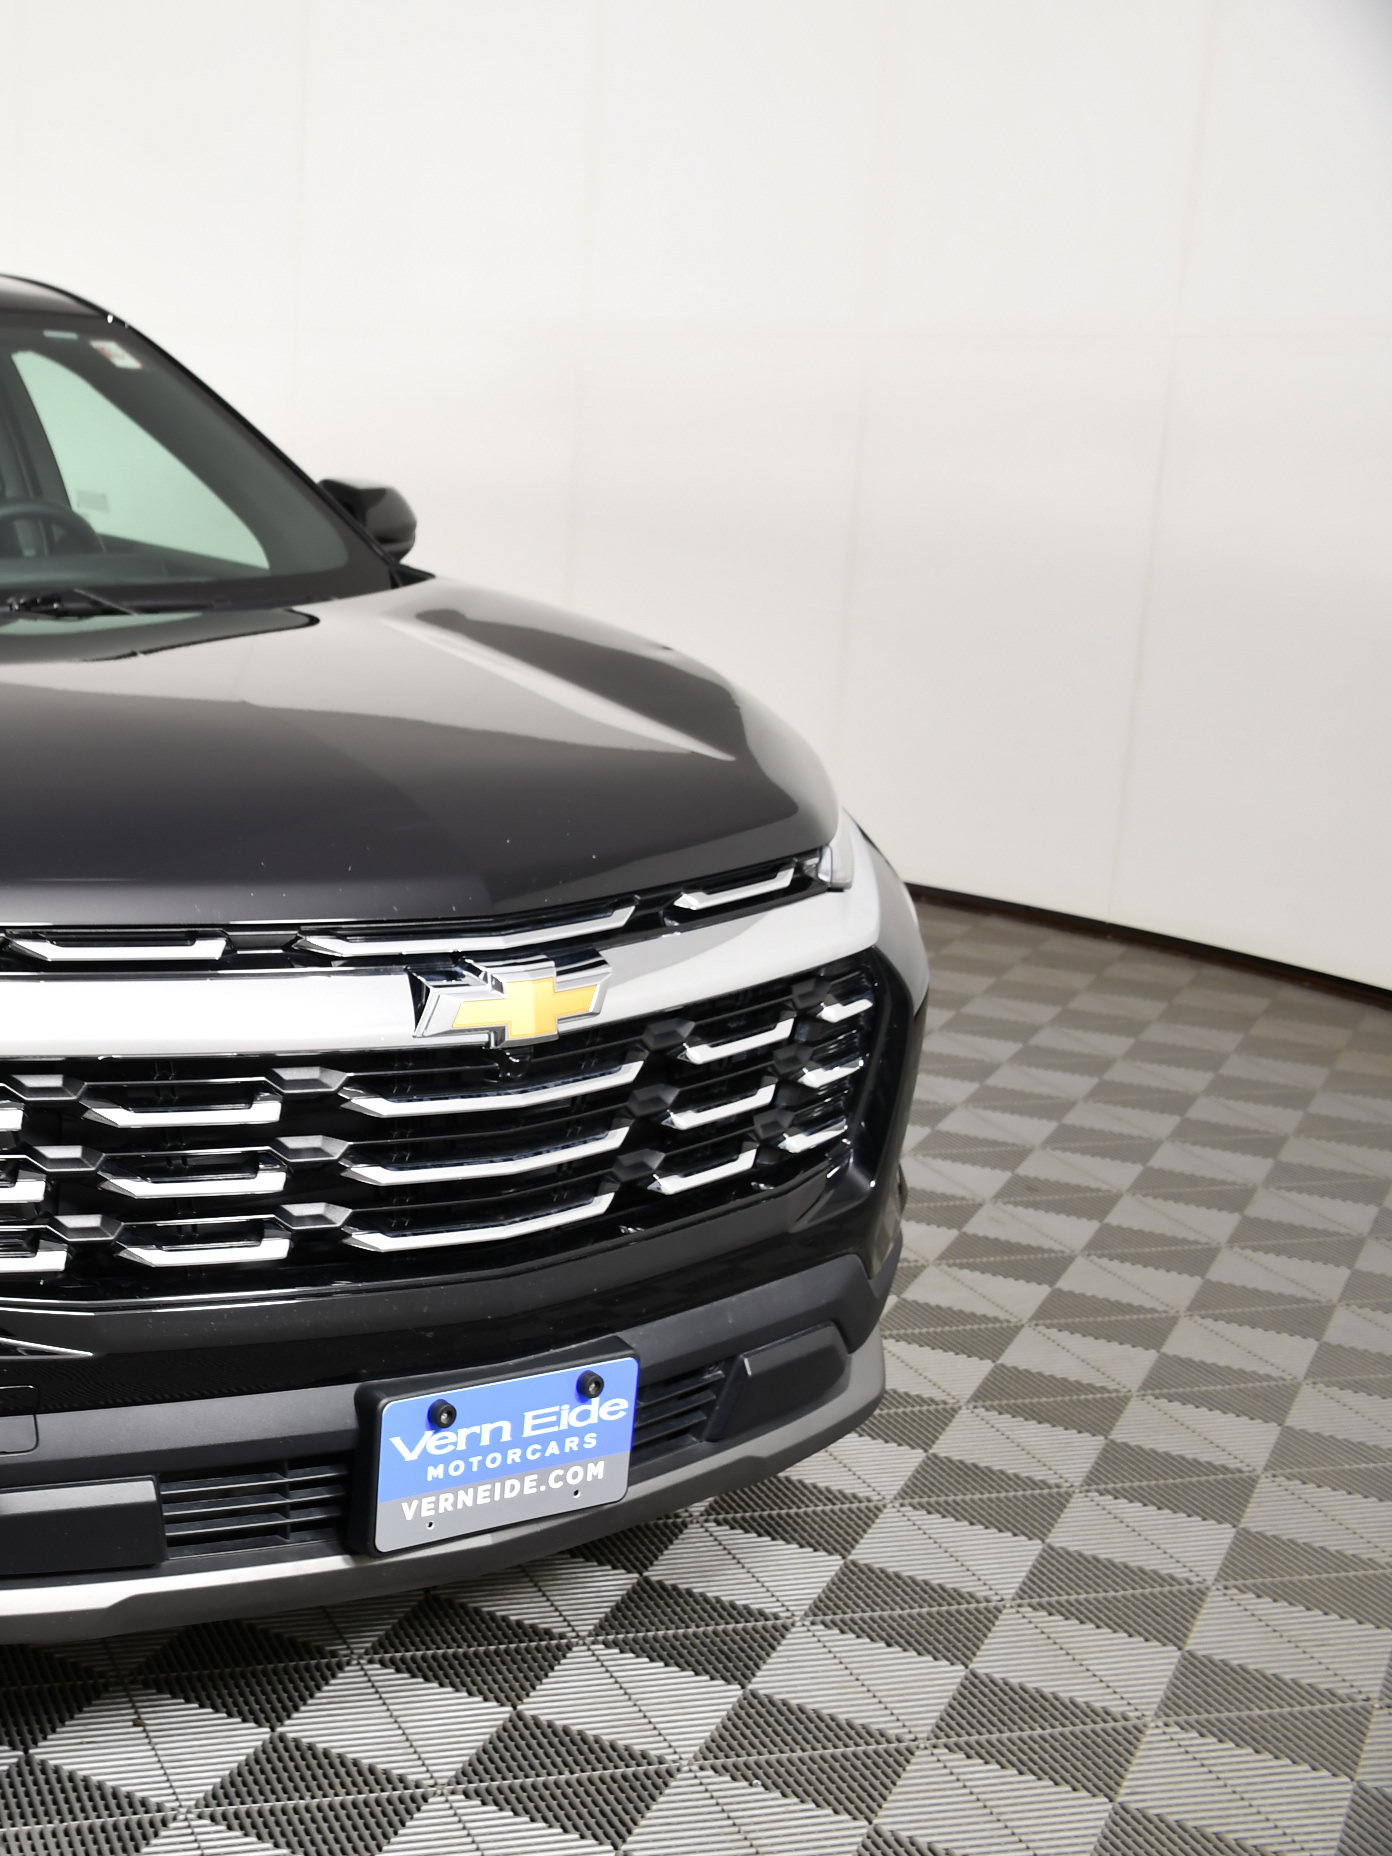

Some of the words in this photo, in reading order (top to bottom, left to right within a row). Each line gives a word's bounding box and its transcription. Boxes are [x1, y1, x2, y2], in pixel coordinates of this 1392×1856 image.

[389, 1419, 511, 1462] Vern
[522, 1397, 629, 1438] Eide
[426, 1433, 597, 1481] MOTORCARS
[401, 1460, 605, 1521] VERNEIDE.COM
